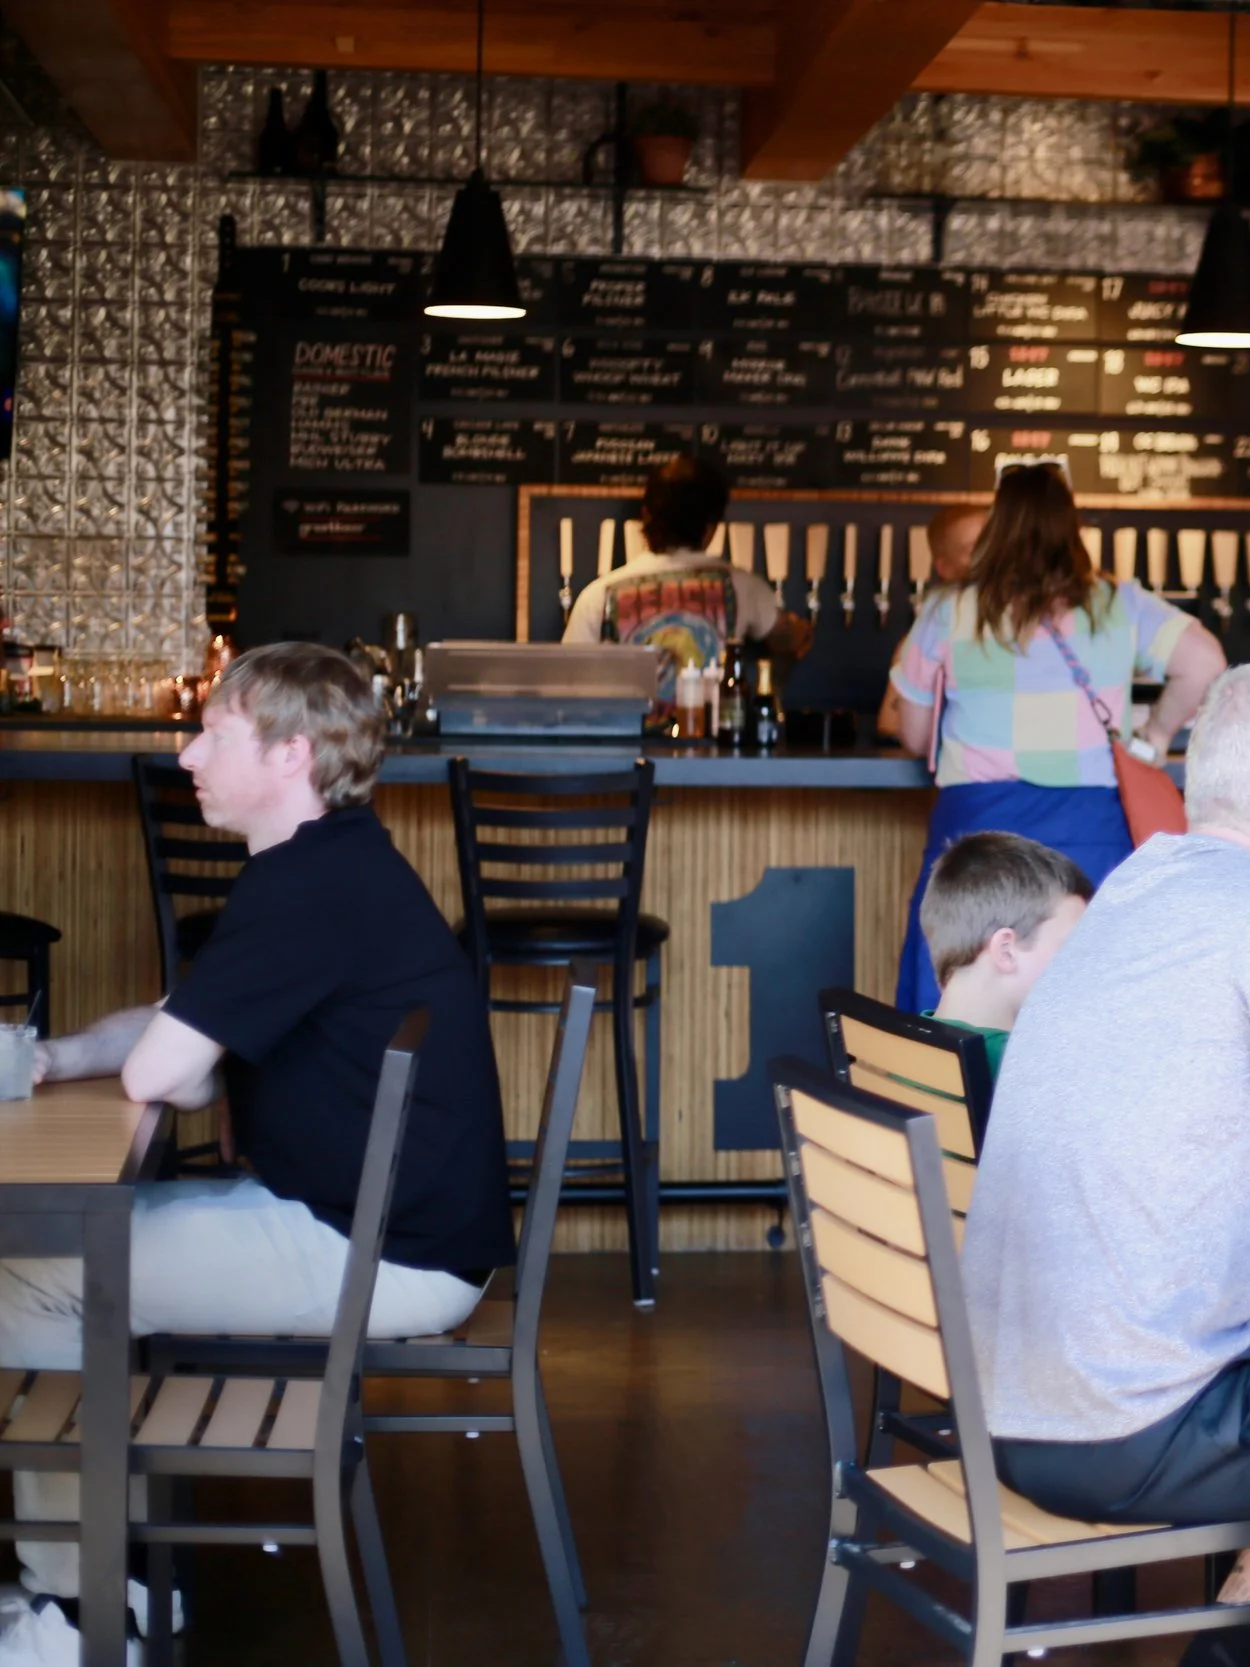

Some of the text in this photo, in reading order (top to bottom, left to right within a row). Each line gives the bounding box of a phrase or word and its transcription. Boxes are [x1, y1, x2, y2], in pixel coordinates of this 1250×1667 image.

[1102, 277, 1124, 301] 17
[294, 341, 397, 369] DOMESTIC
[561, 336, 576, 358] 6
[1002, 367, 1060, 388] LAGER
[334, 458, 386, 472] ULTRA
[711, 867, 856, 1150] 1
